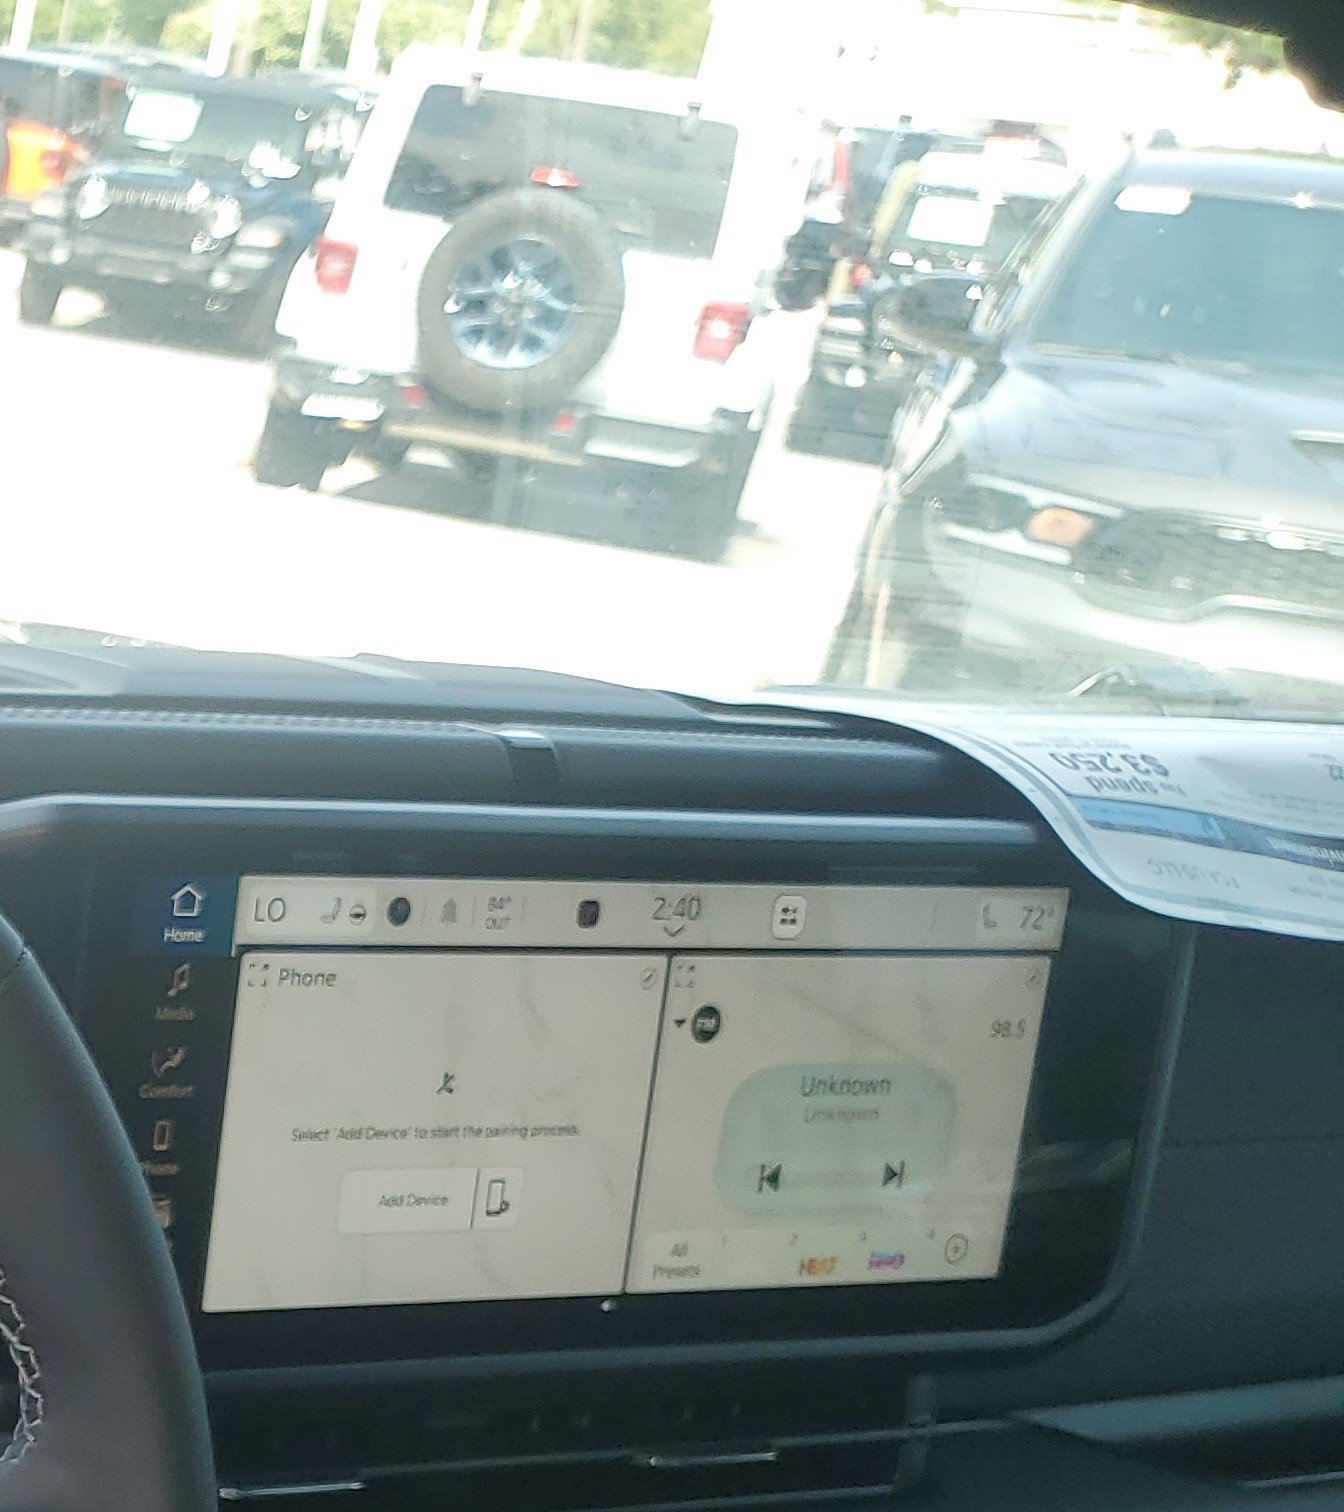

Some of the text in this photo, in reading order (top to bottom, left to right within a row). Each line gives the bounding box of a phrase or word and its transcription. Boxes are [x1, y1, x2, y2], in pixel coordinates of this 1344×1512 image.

[253, 896, 286, 922] LO
[650, 895, 702, 921] 2:40
[164, 927, 204, 942] Home
[278, 966, 337, 987] Phone
[798, 1074, 892, 1097] Unknown
[291, 1126, 328, 1141] Select
[430, 1125, 459, 1139] start
[462, 1124, 481, 1138] the
[378, 1193, 448, 1206] Add Device
